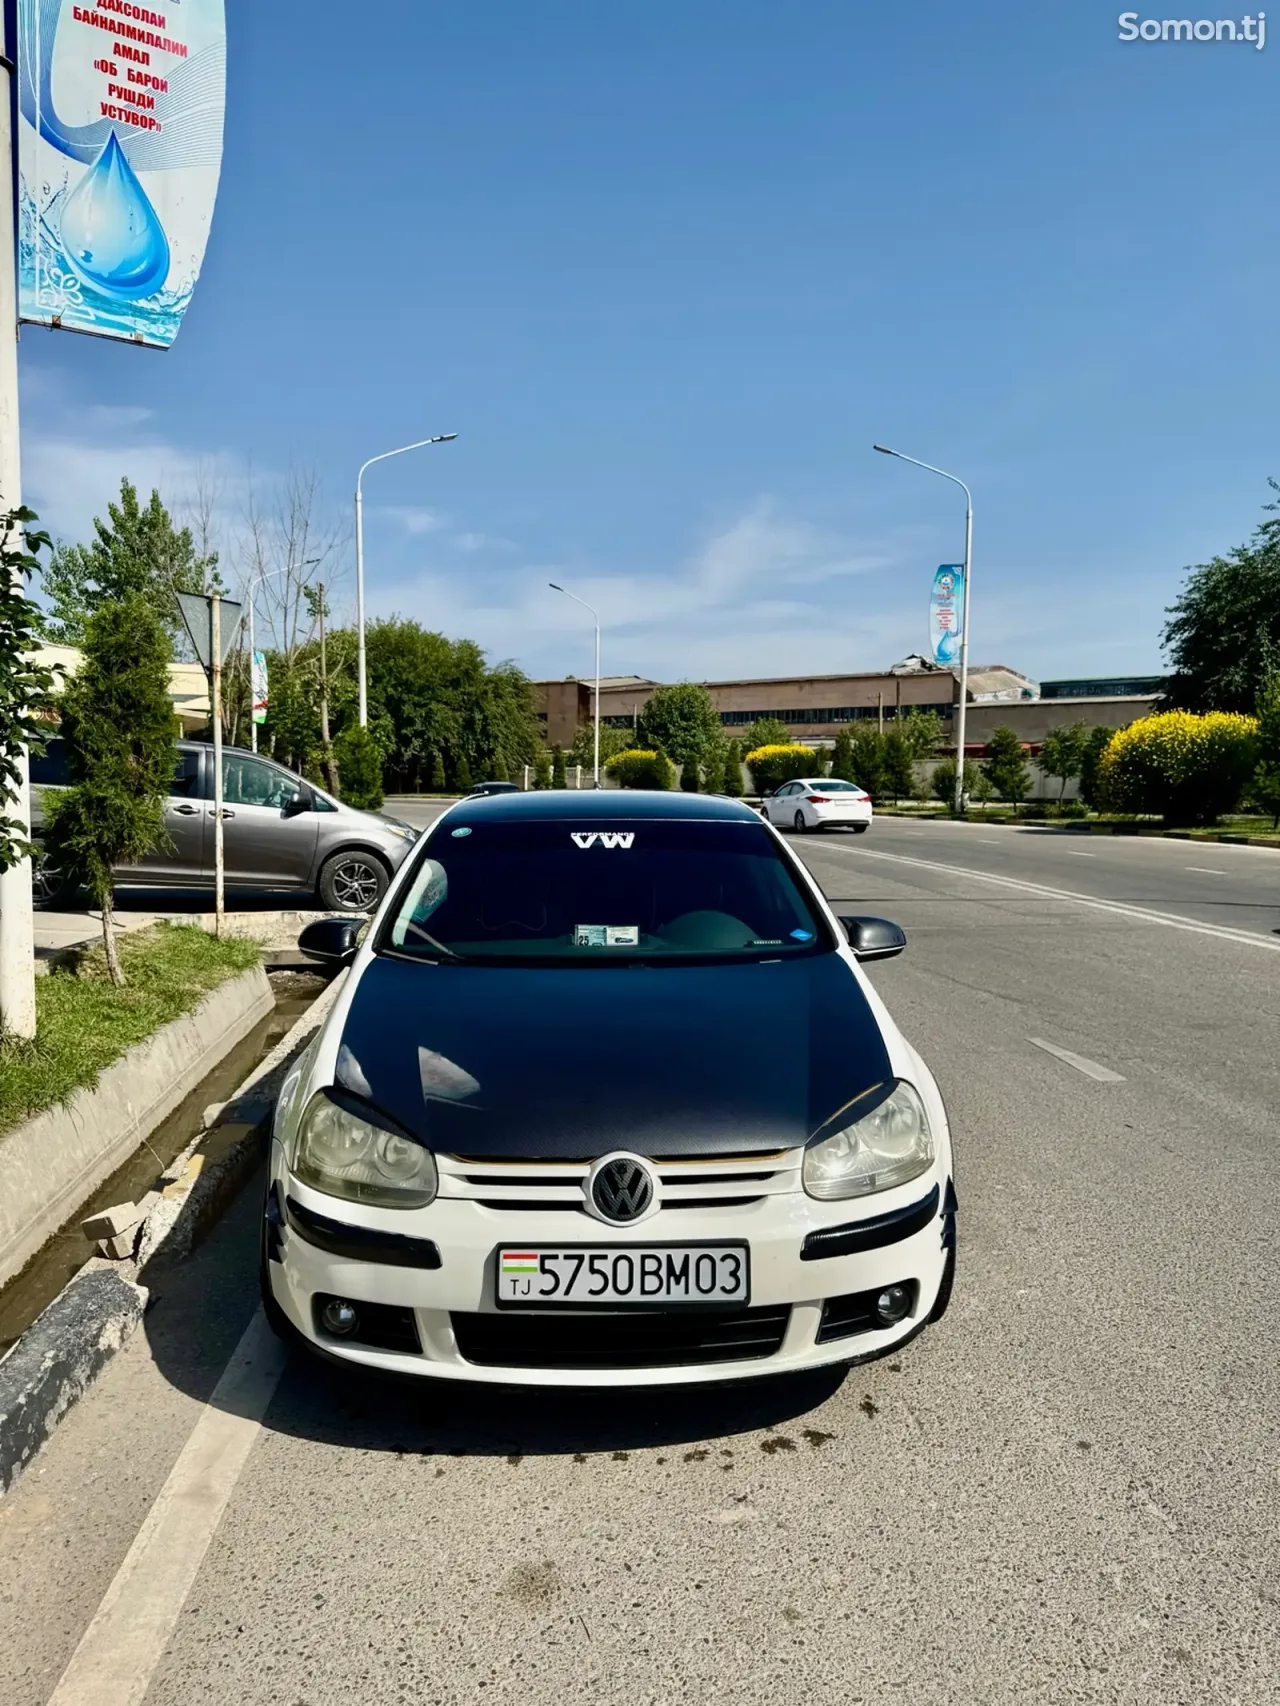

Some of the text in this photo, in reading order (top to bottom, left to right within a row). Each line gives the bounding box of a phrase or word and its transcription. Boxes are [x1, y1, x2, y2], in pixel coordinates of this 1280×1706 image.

[73, 6, 187, 58] БАЙНАЛМИЛАЛИИ
[113, 42, 150, 66] АМАЛ
[94, 59, 168, 93] «ОБ БАРОИ
[108, 83, 155, 110] РУШДИ
[100, 102, 162, 132] УСТУВОР»
[593, 1158, 653, 1221] VW
[510, 1279, 531, 1296] TJ
[539, 1253, 741, 1296] 5750BM03
